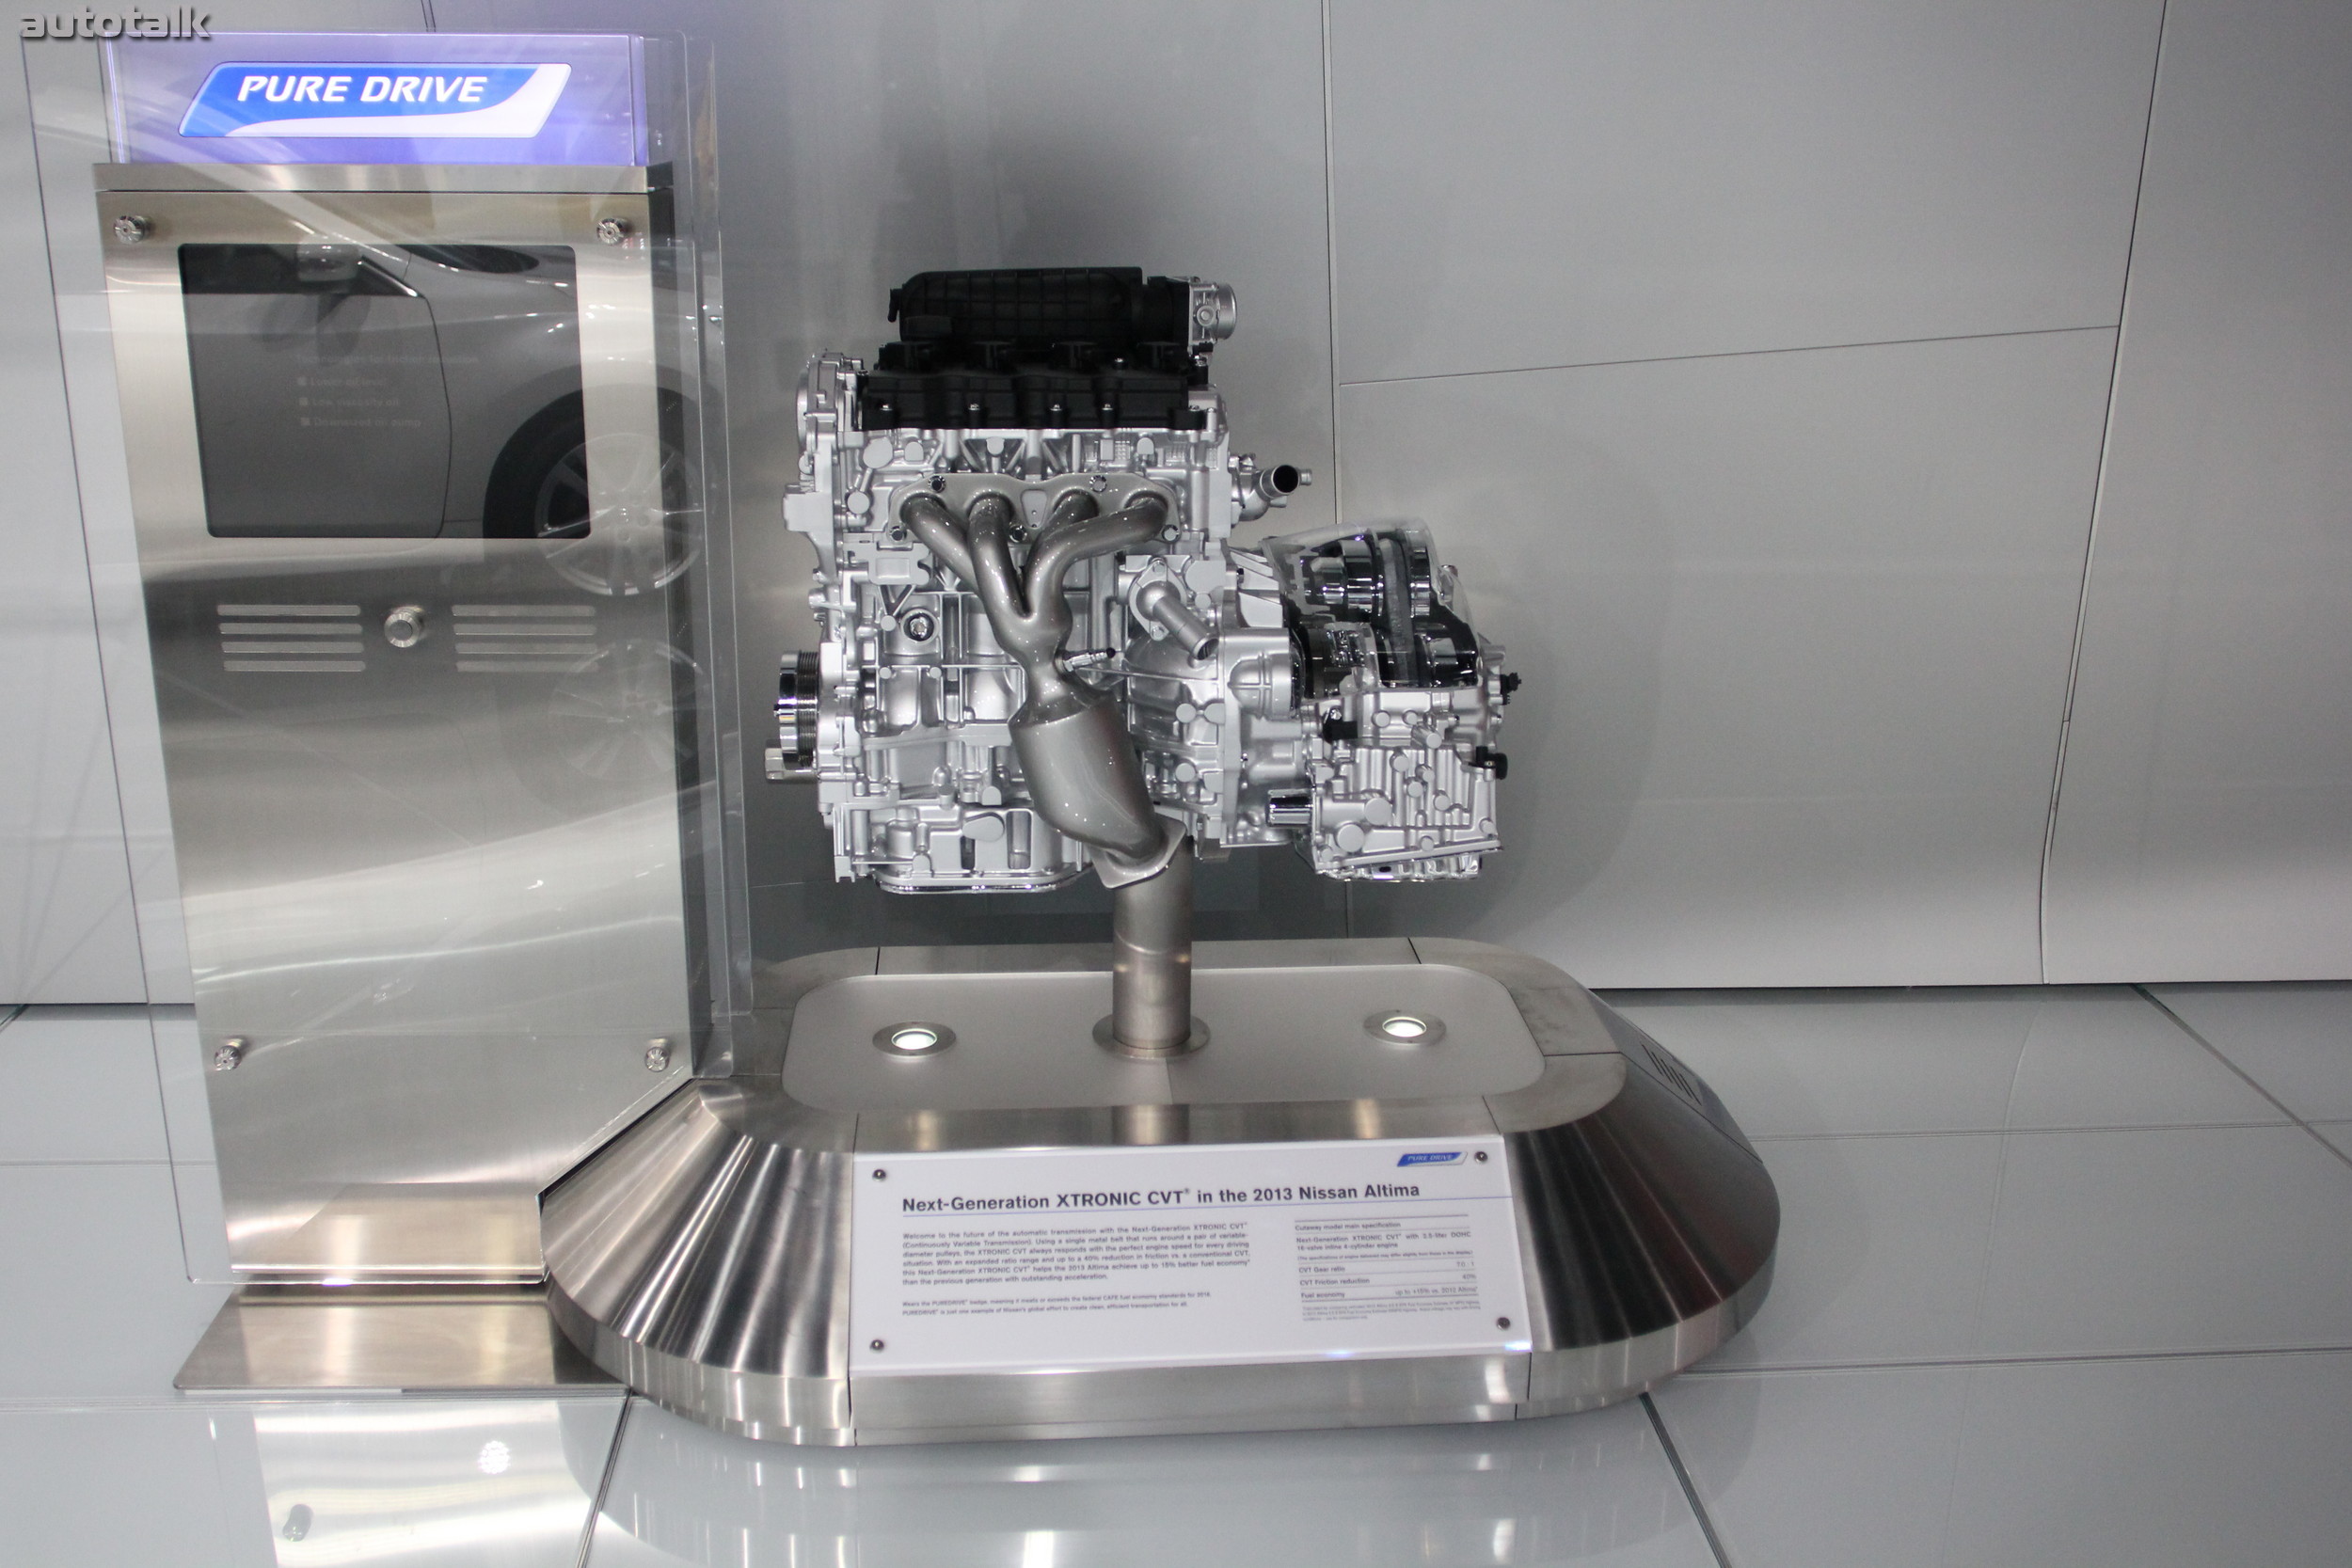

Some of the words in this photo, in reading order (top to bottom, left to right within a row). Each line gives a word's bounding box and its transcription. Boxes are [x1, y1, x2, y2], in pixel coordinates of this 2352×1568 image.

[236, 74, 347, 103] PURE
[359, 74, 487, 103] DRIVE
[902, 1195, 1050, 1212] Next-Generation
[1057, 1191, 1141, 1208] XTRONIC
[1197, 1189, 1213, 1204] in
[1218, 1189, 1248, 1203] the
[1253, 1187, 1293, 1202] 2013
[1298, 1184, 1359, 1200] Nissan
[1363, 1182, 1421, 1198] Altima
[1131, 1225, 1192, 1233] Next-Generation
[1192, 1223, 1225, 1231] XTRONIC
